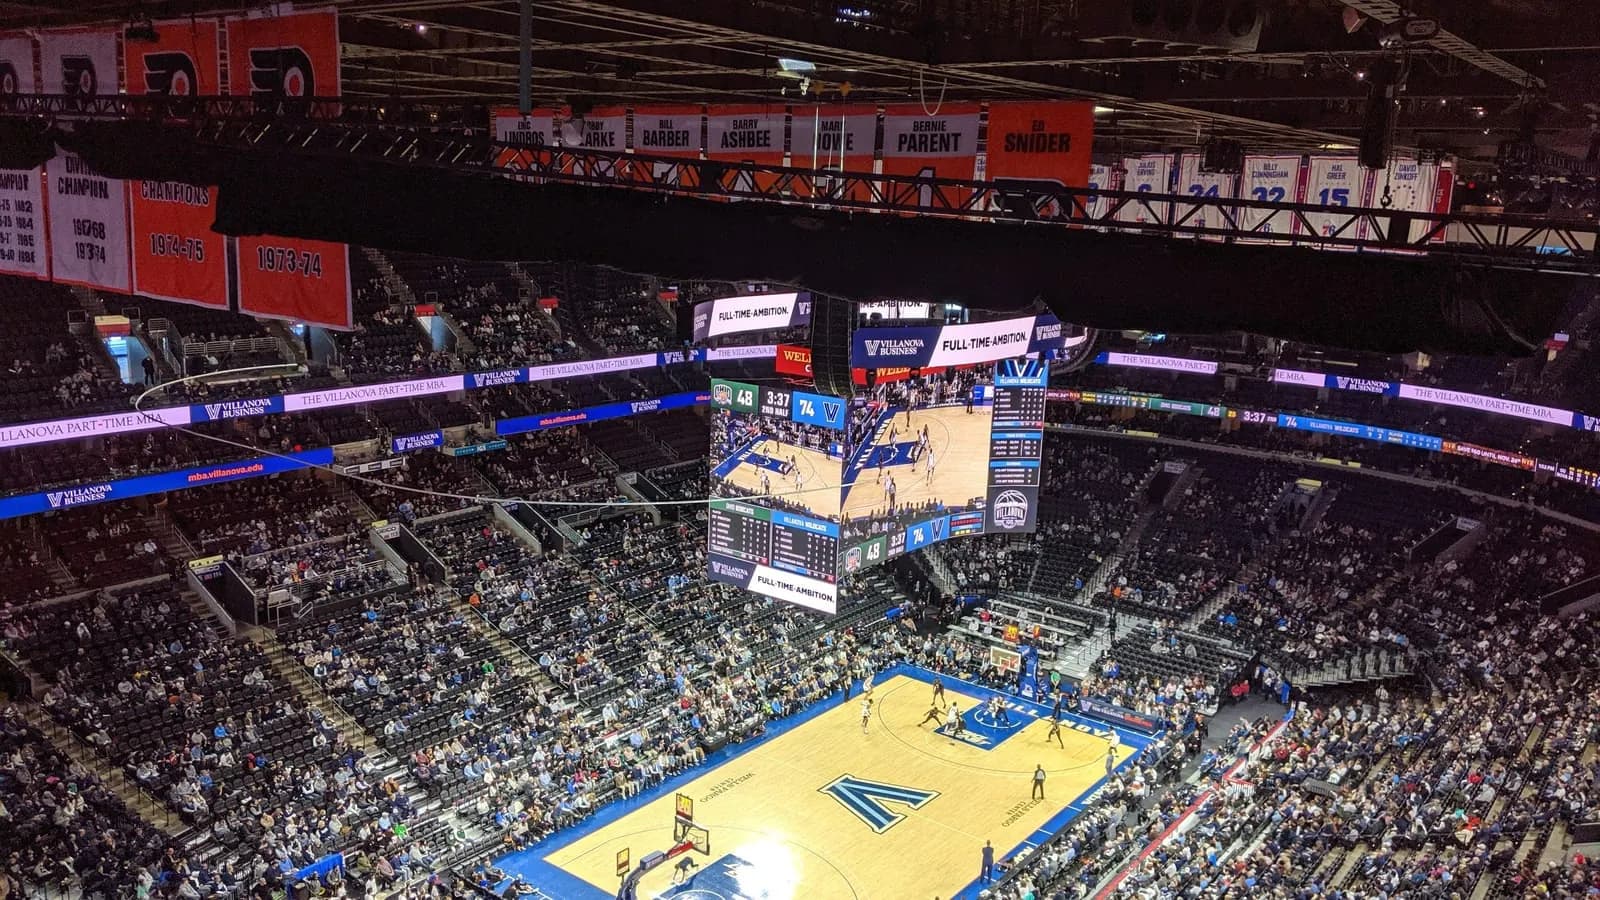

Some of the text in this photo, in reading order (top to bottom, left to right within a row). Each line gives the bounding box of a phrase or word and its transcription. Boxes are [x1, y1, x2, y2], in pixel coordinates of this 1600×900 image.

[659, 119, 673, 129] BILL
[732, 119, 758, 130] BARRY
[912, 119, 947, 132] BERNIE
[1031, 119, 1045, 132] ED
[579, 131, 615, 147] ARKE
[643, 129, 689, 147] BARBER
[720, 130, 771, 148] ASHBEE
[897, 132, 961, 153] PARENT
[1004, 132, 1071, 153] SNIDER
[1263, 163, 1279, 171] BILLY
[1331, 164, 1343, 172] HAL
[1398, 164, 1417, 172] DAVID
[1252, 170, 1289, 179] CUNNINGHAM
[1327, 171, 1346, 180] GREER
[1394, 172, 1418, 181] ZINKOFF
[141, 179, 209, 206] CHAMPIONS
[149, 232, 205, 262] 1974-75
[256, 244, 322, 279] 1973-74
[881, 338, 924, 348] VILLANOVA
[880, 346, 918, 356] BUSINESS
[486, 370, 520, 379] VILLANOVA
[486, 376, 515, 386] BUSINESS
[1349, 383, 1383, 393] BUSINESS
[1350, 378, 1390, 389] VILLANOVA
[301, 395, 321, 405] THE
[323, 388, 377, 404] VILLANOVA
[378, 382, 425, 396] PART-TIME
[737, 389, 752, 406] 48
[767, 391, 790, 407] 3:37
[222, 398, 272, 411] VILLANOVA
[799, 399, 815, 417] 74
[1414, 388, 1433, 398] THE
[1434, 390, 1485, 407] VILLANOVA
[1485, 399, 1531, 415] PART-TIME
[222, 406, 265, 418] BUSINESS
[1207, 406, 1220, 417] 48
[1243, 410, 1266, 423] 3:37
[67, 415, 133, 433] PART-TIME
[1285, 416, 1297, 428] 74
[406, 432, 440, 443] VILLANOVA
[406, 439, 434, 449] BUSINESS
[188, 463, 263, 482] mba.villanova.edu
[64, 484, 112, 498] VILLANOVA
[64, 491, 106, 505] BUSINESS
[891, 532, 905, 547] 3:37
[913, 529, 924, 544] 74
[867, 542, 880, 561] 48
